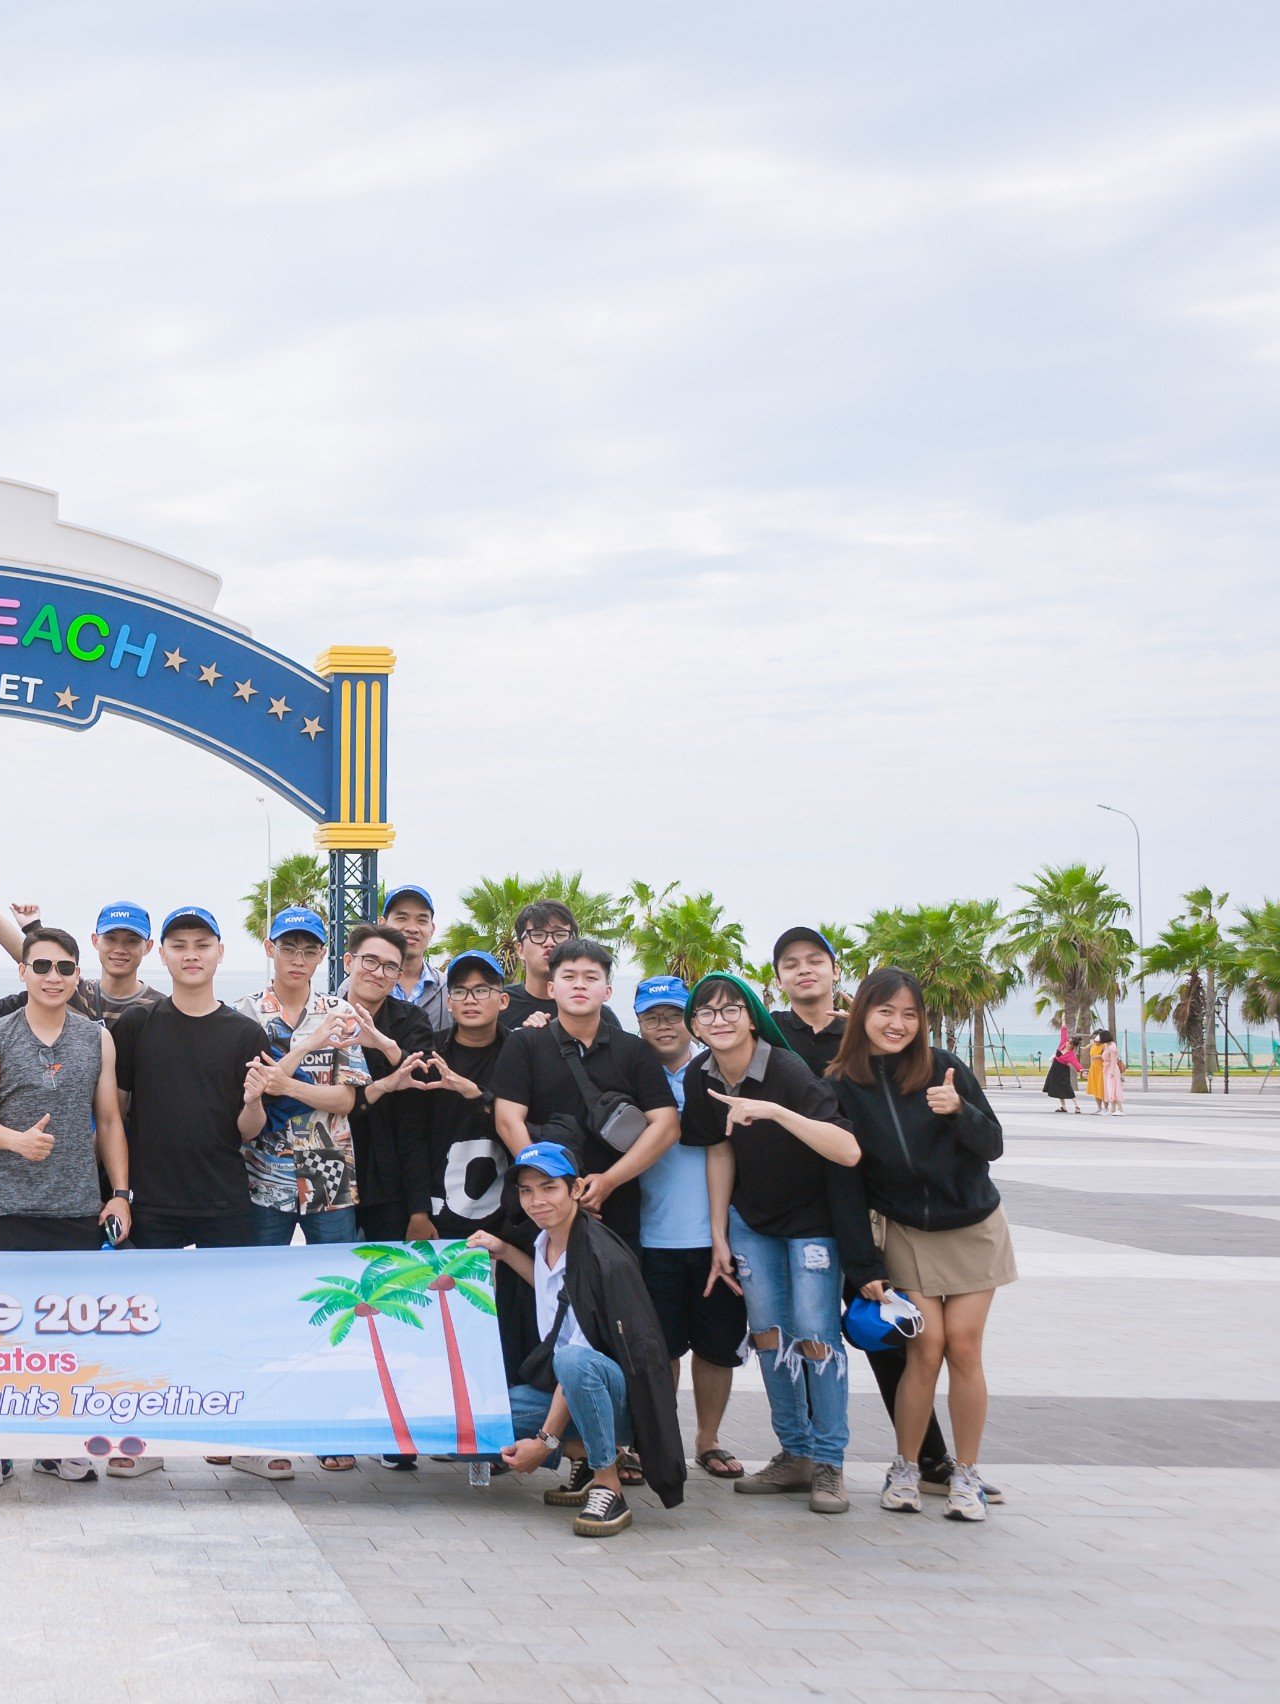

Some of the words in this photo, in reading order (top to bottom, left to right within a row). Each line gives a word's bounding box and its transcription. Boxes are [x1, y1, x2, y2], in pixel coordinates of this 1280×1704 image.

[648, 985, 669, 993] KIWI
[520, 1149, 539, 1161] KIWI
[35, 1293, 161, 1335] 2023
[70, 1385, 245, 1424] Together
